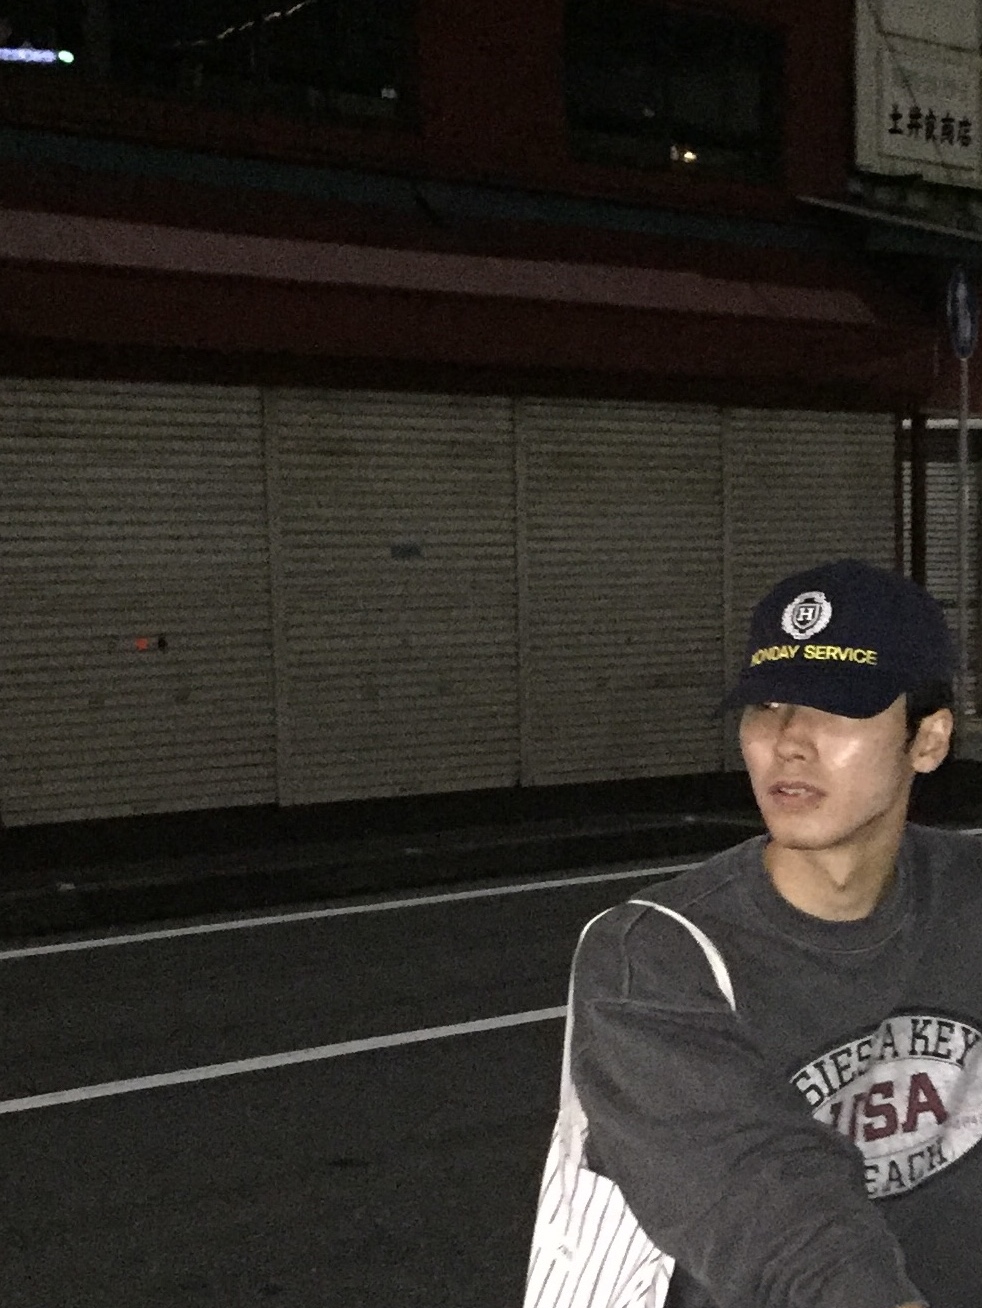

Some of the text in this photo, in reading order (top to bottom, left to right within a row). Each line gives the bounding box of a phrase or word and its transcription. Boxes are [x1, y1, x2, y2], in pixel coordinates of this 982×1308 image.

[797, 607, 815, 621] H
[803, 645, 878, 665] SERVICE
[794, 1018, 980, 1108] SIESA KEY
[864, 1141, 947, 1195] EACH
